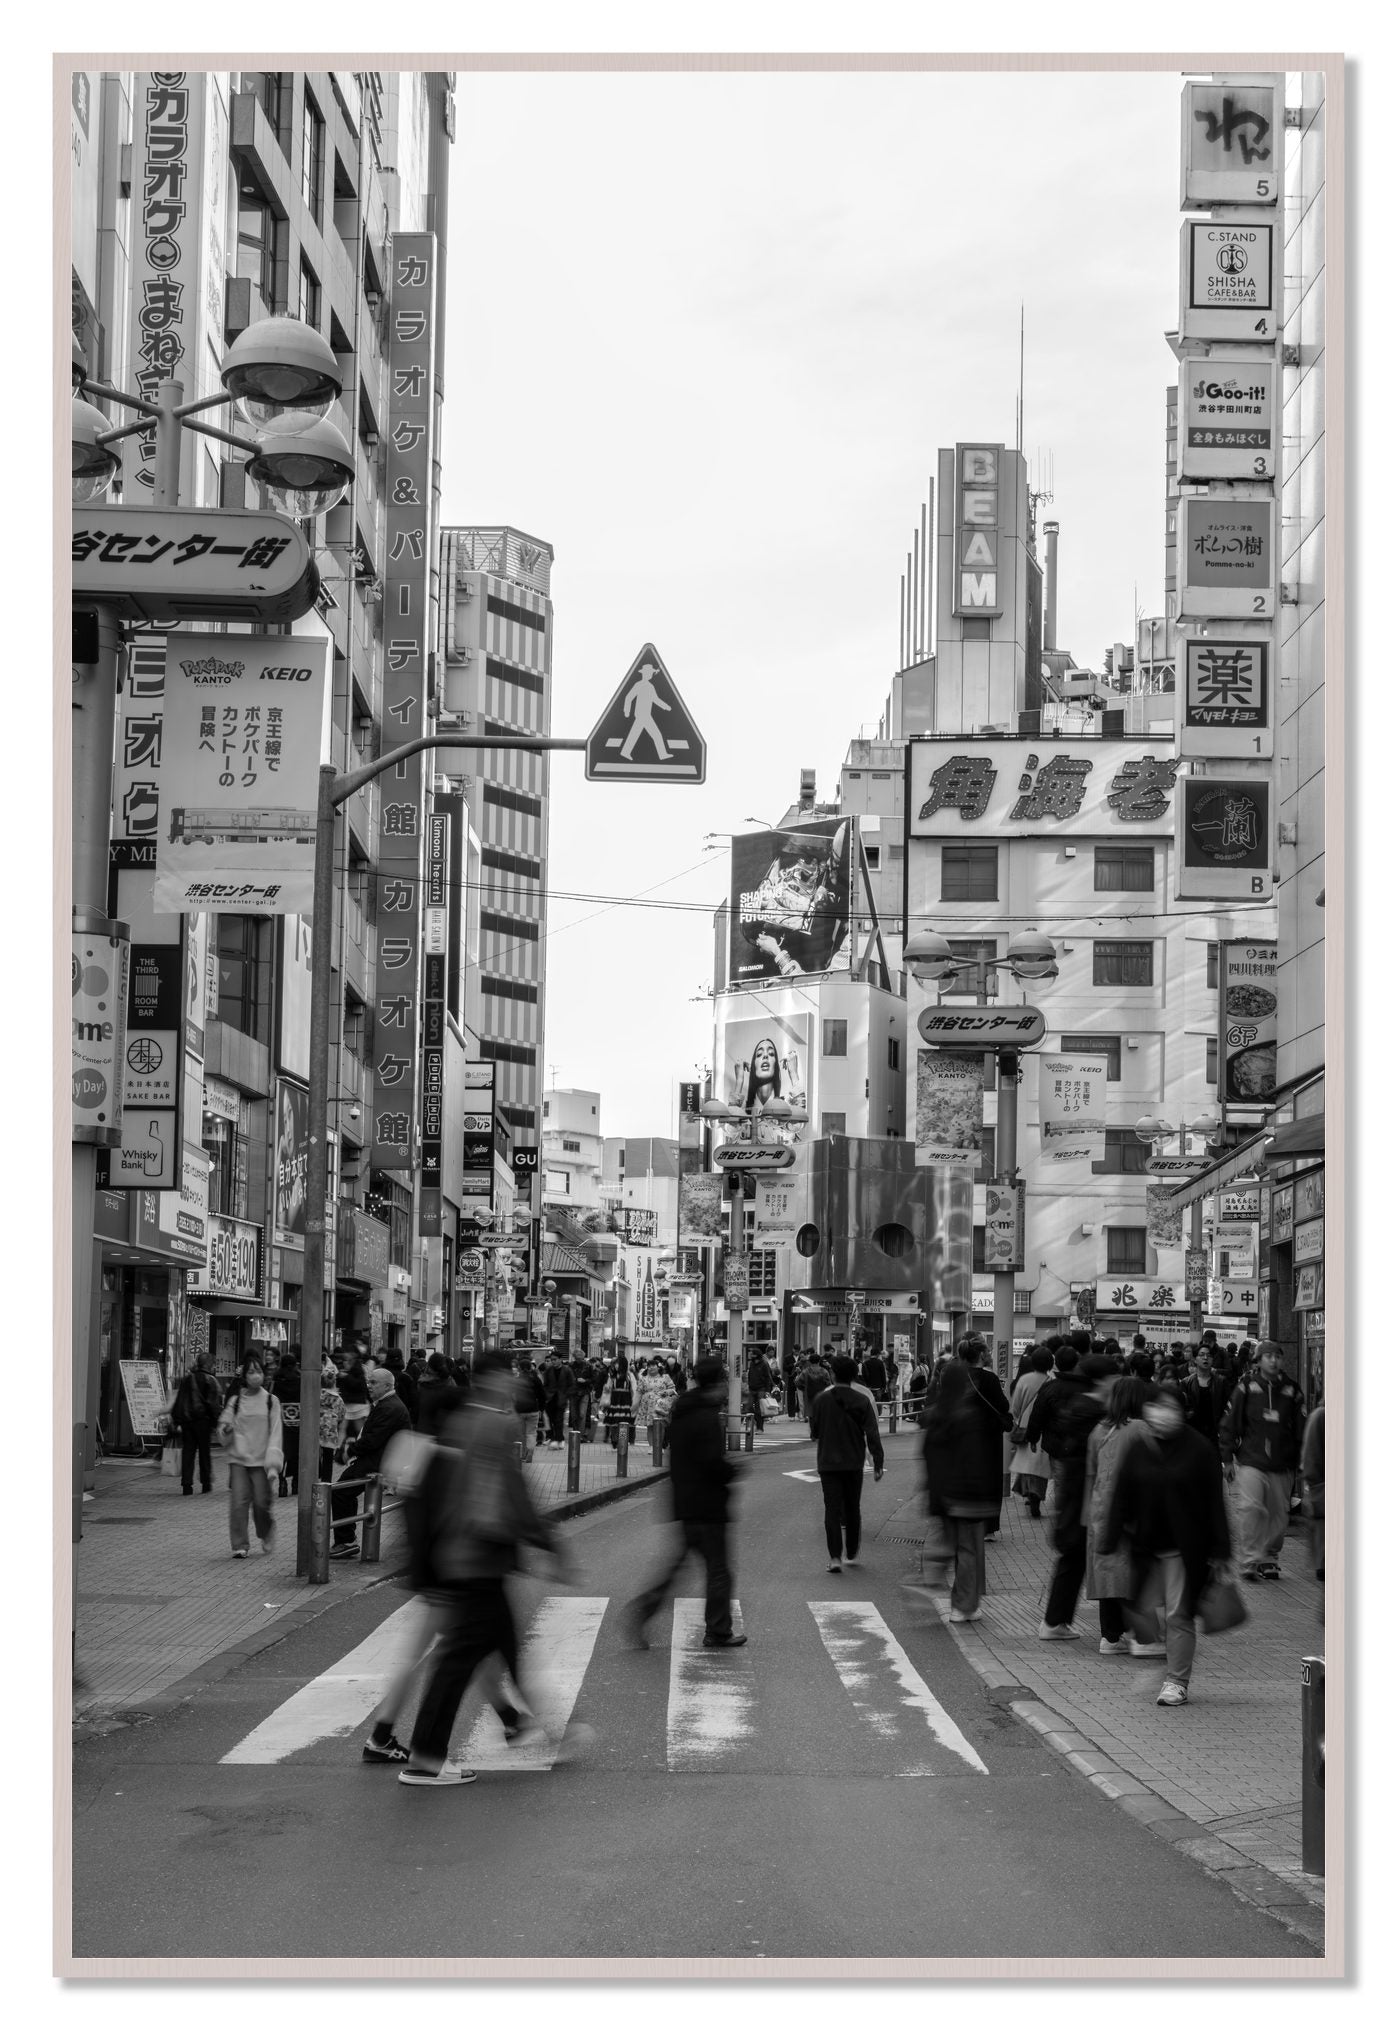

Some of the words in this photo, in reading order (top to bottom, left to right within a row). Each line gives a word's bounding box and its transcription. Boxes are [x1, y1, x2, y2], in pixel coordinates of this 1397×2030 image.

[143, 88, 189, 238] カラオケ
[1256, 179, 1269, 197] 5
[1207, 232, 1257, 243] C.STAND
[1207, 276, 1256, 288] SHISHA
[1207, 288, 1256, 298] CAFE&BAR
[1254, 318, 1268, 335] 4
[1198, 404, 1262, 415] 渋谷宇田川町店
[1193, 432, 1266, 444] 全身もみほぐし
[1253, 457, 1267, 475] 3
[963, 449, 998, 607] BEAM
[1193, 534, 1264, 555] ポムの樹
[1252, 595, 1266, 613] 2
[193, 676, 232, 684] KANTO
[260, 667, 313, 682] KEIO
[1197, 649, 1253, 705] 薬
[1191, 708, 1259, 724] マツモトキヨシ
[198, 706, 216, 752] 冒険へ
[218, 706, 238, 787] カントーの
[241, 705, 261, 788] ポケパーク
[264, 707, 283, 772] 京王線で
[1252, 735, 1262, 753] 1
[917, 754, 1179, 821] 角海老
[433, 820, 442, 858] kimono
[432, 864, 442, 901] hearts
[1251, 876, 1264, 893] B
[184, 884, 282, 898] 渋谷センター街
[135, 966, 159, 974] THIRD
[139, 958, 156, 966] THE
[1229, 963, 1277, 976] 四川料理
[135, 997, 158, 1005] ROOM
[138, 1009, 154, 1017] BAR
[375, 879, 415, 1147] カラオケ館
[926, 1016, 1039, 1030] 渋谷センター街
[1226, 1026, 1258, 1048] 6F
[83, 1079, 105, 1094] Day!
[121, 1150, 158, 1162] Whisky
[121, 1159, 143, 1169] Bank
[515, 1153, 537, 1165] GU
[96, 1171, 108, 1183] 1F
[1112, 1284, 1176, 1308] 兆楽
[644, 1282, 653, 1328] BEER
[641, 1329, 656, 1338] HALL
